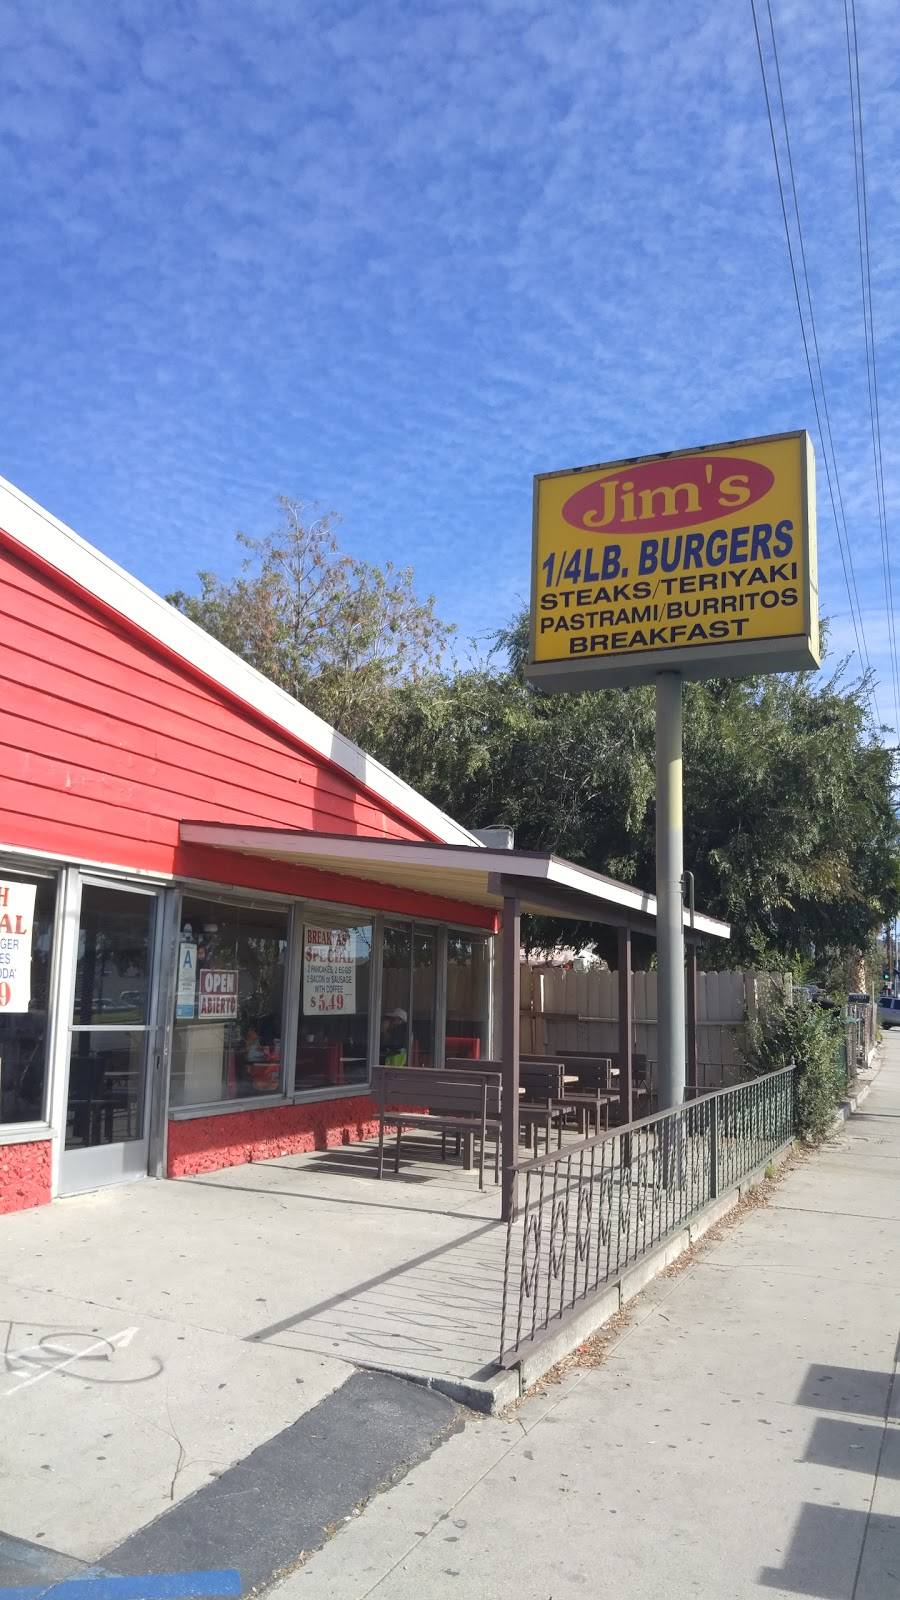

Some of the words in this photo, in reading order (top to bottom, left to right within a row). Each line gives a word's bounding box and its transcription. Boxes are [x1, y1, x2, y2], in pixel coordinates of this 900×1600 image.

[582, 464, 751, 527] Jim's
[542, 544, 628, 588] 1/4LB.
[638, 520, 794, 576] BURGERS
[540, 562, 797, 611] STEAKS/TERIYAKI
[540, 588, 798, 634] PASTRAMI/BURRITOS
[569, 618, 749, 654] BREAKFAST
[183, 950, 192, 968] A
[204, 972, 235, 993] OPEN
[326, 985, 344, 994] COFFEE
[201, 996, 236, 1014] ABIERTO
